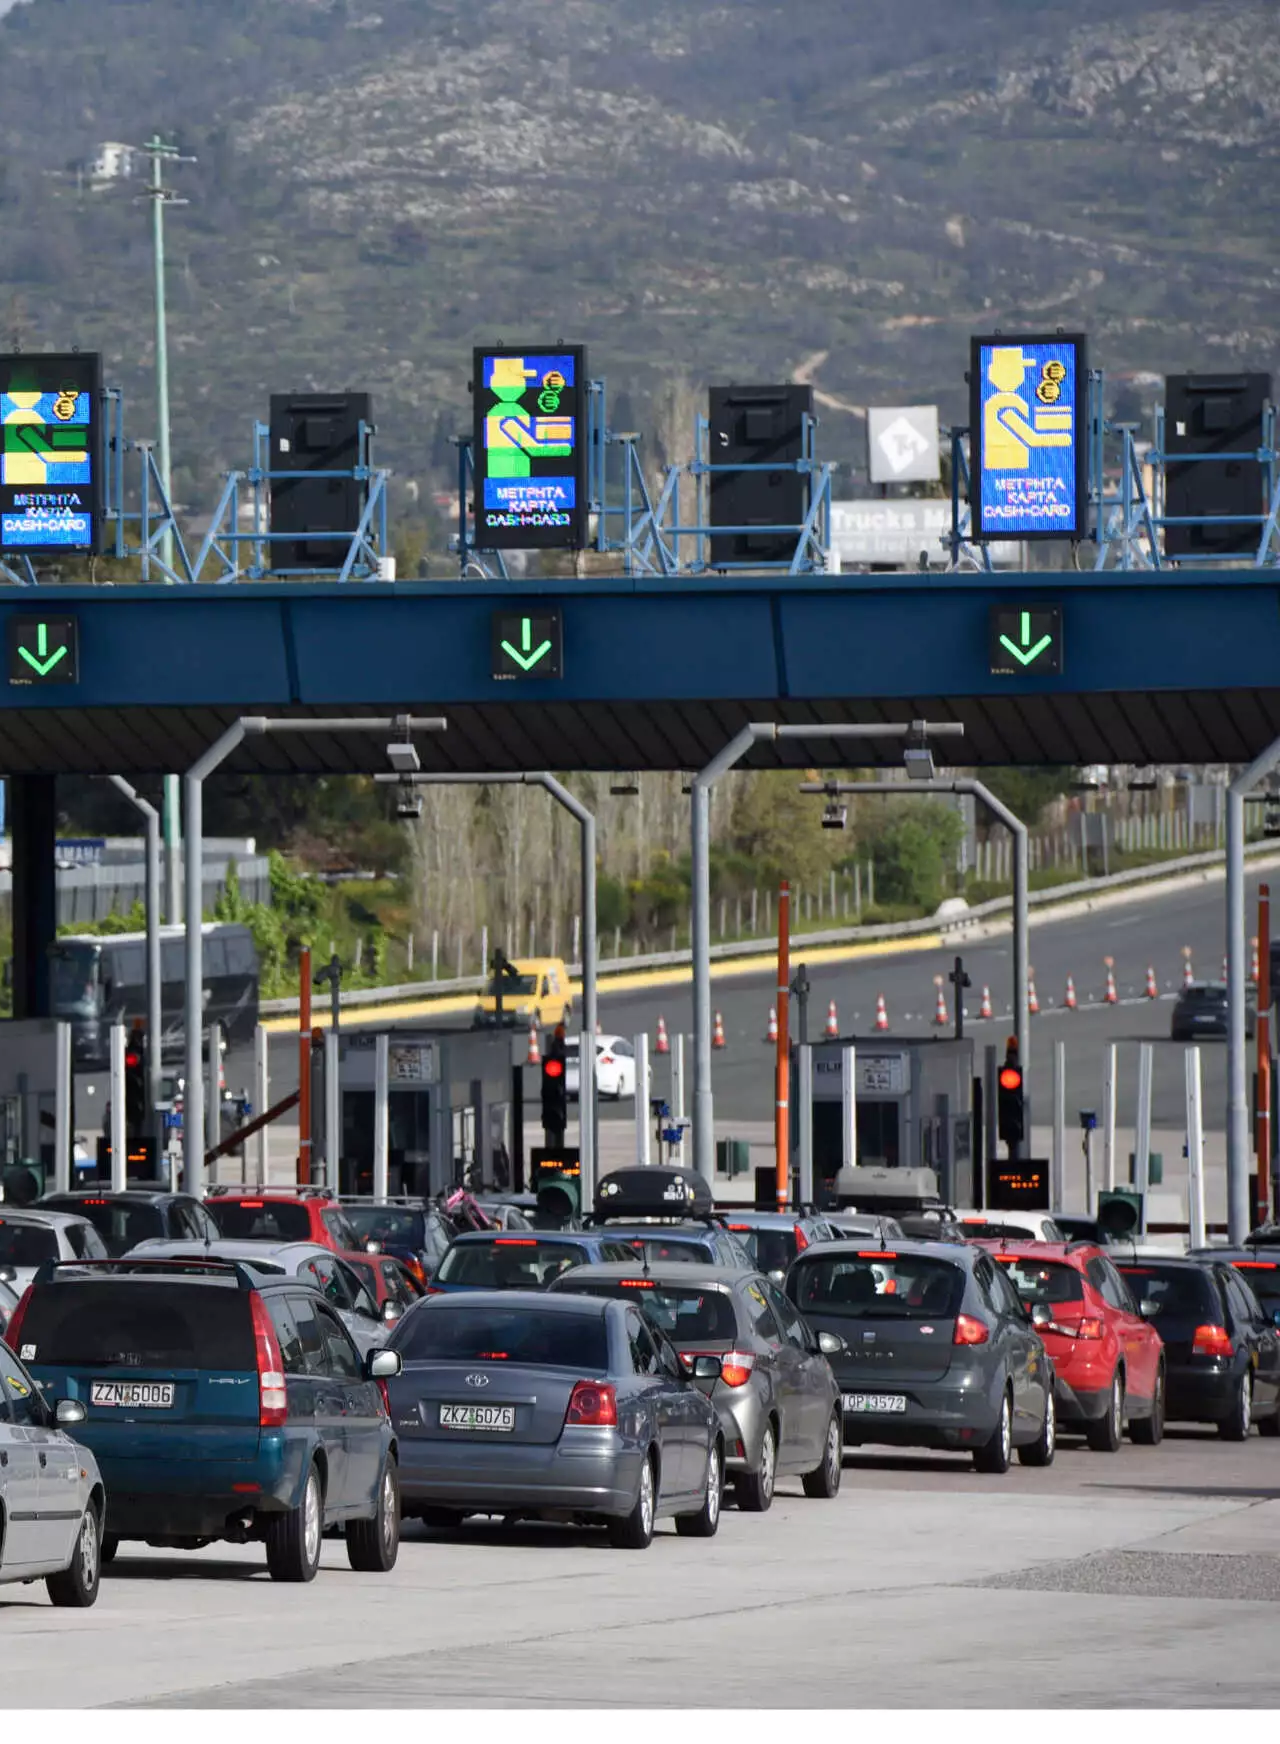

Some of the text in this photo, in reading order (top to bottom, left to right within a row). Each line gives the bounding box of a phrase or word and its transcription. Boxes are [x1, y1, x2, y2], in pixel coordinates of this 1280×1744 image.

[93, 1383, 171, 1403] ZZN 6006
[442, 1406, 511, 1425] ZKZ 6076
